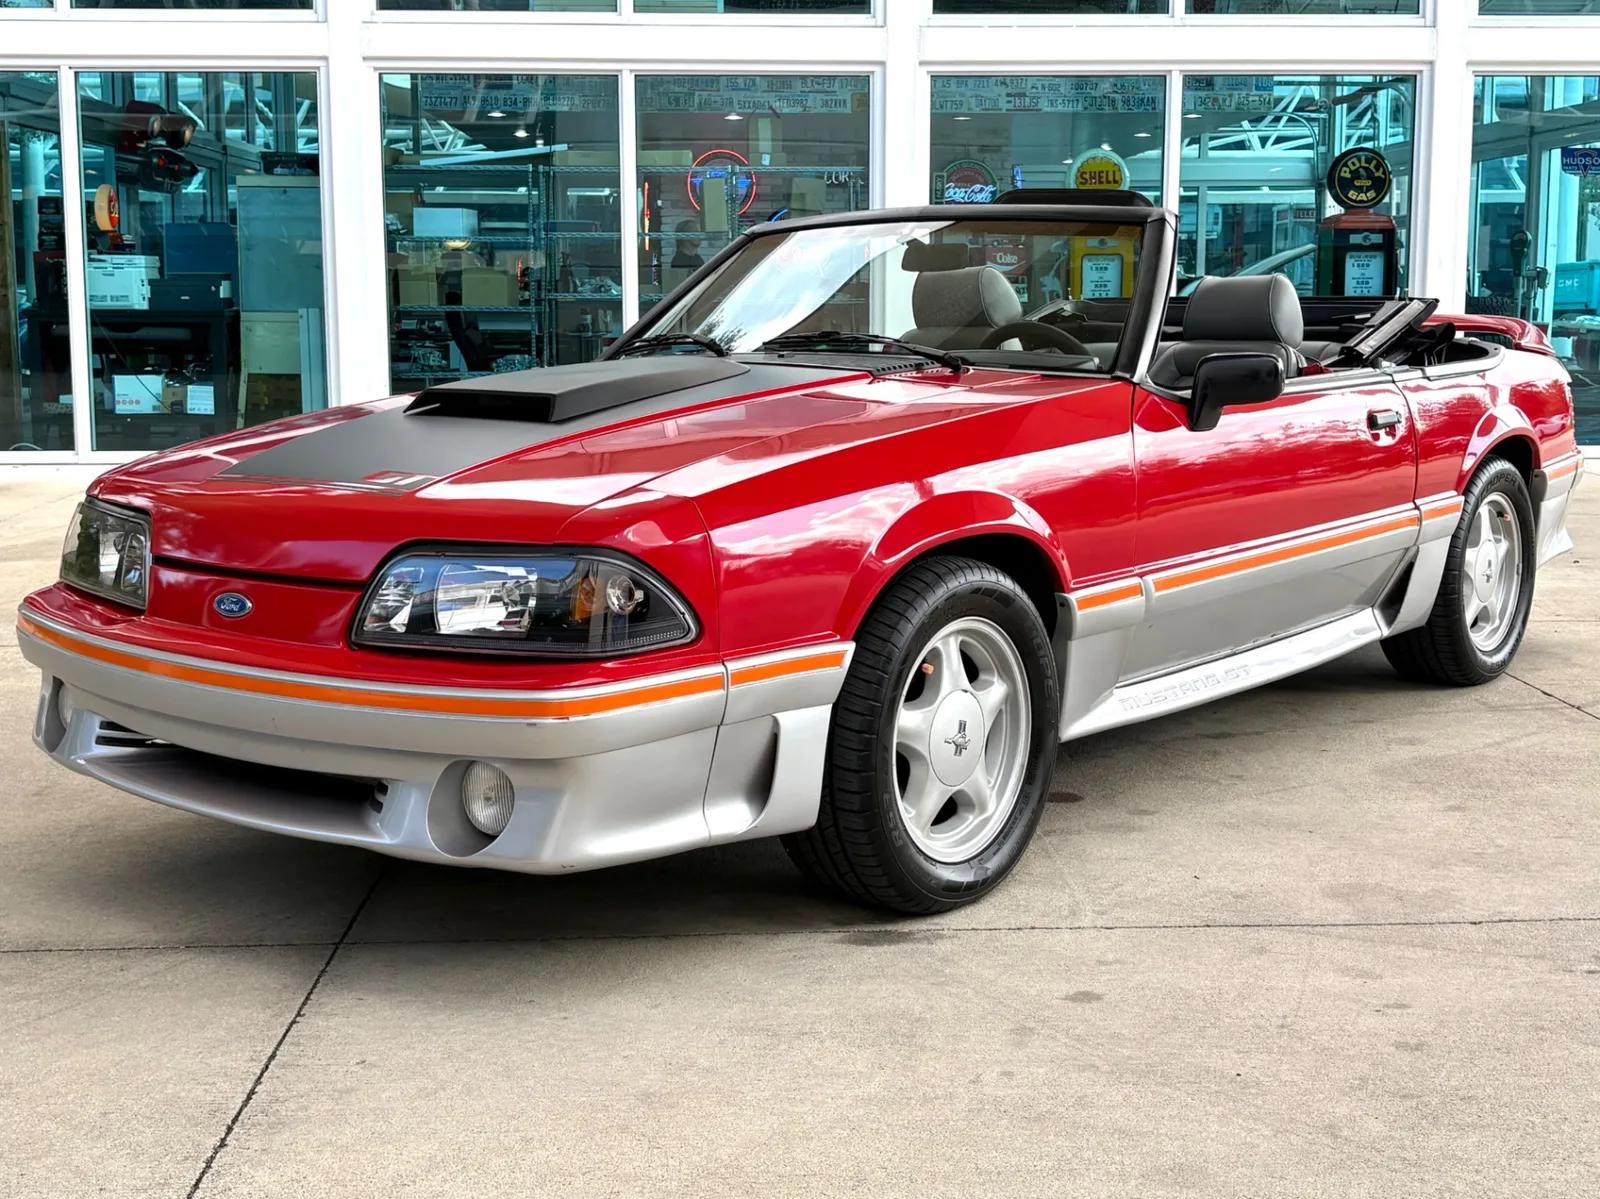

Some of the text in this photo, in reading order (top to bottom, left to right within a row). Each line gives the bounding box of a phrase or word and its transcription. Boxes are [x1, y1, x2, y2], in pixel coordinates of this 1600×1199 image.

[1340, 156, 1385, 178] POLLY
[1079, 170, 1119, 185] SHELL
[1347, 190, 1377, 202] GAS
[996, 252, 1018, 264] Coke
[220, 596, 242, 611] Ford
[1118, 664, 1251, 711] MUSTANG GT
